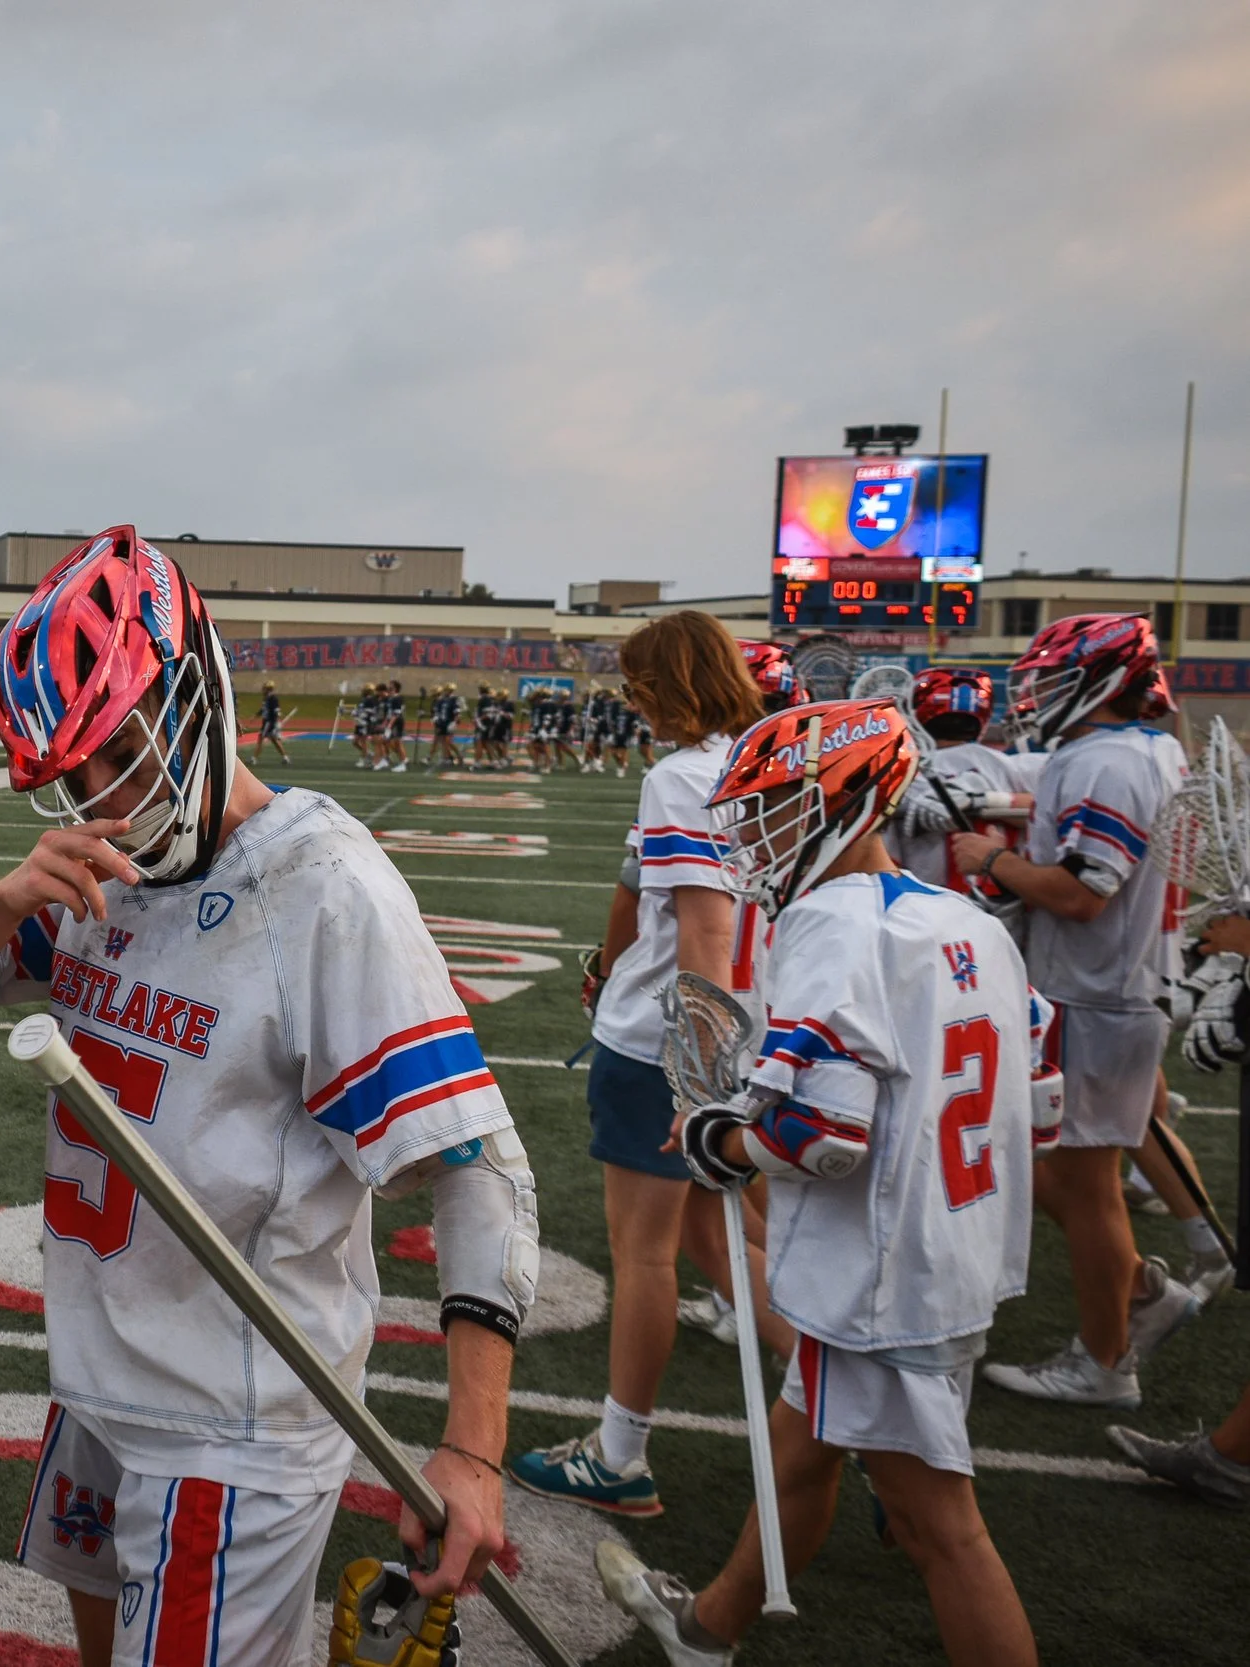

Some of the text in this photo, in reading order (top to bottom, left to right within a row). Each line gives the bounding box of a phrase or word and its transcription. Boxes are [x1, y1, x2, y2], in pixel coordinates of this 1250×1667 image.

[233, 638, 555, 670] WESTLAKE FOOTBALL
[776, 711, 890, 772] Wstlake
[940, 1014, 1000, 1212] 2
[561, 1459, 596, 1488] N
